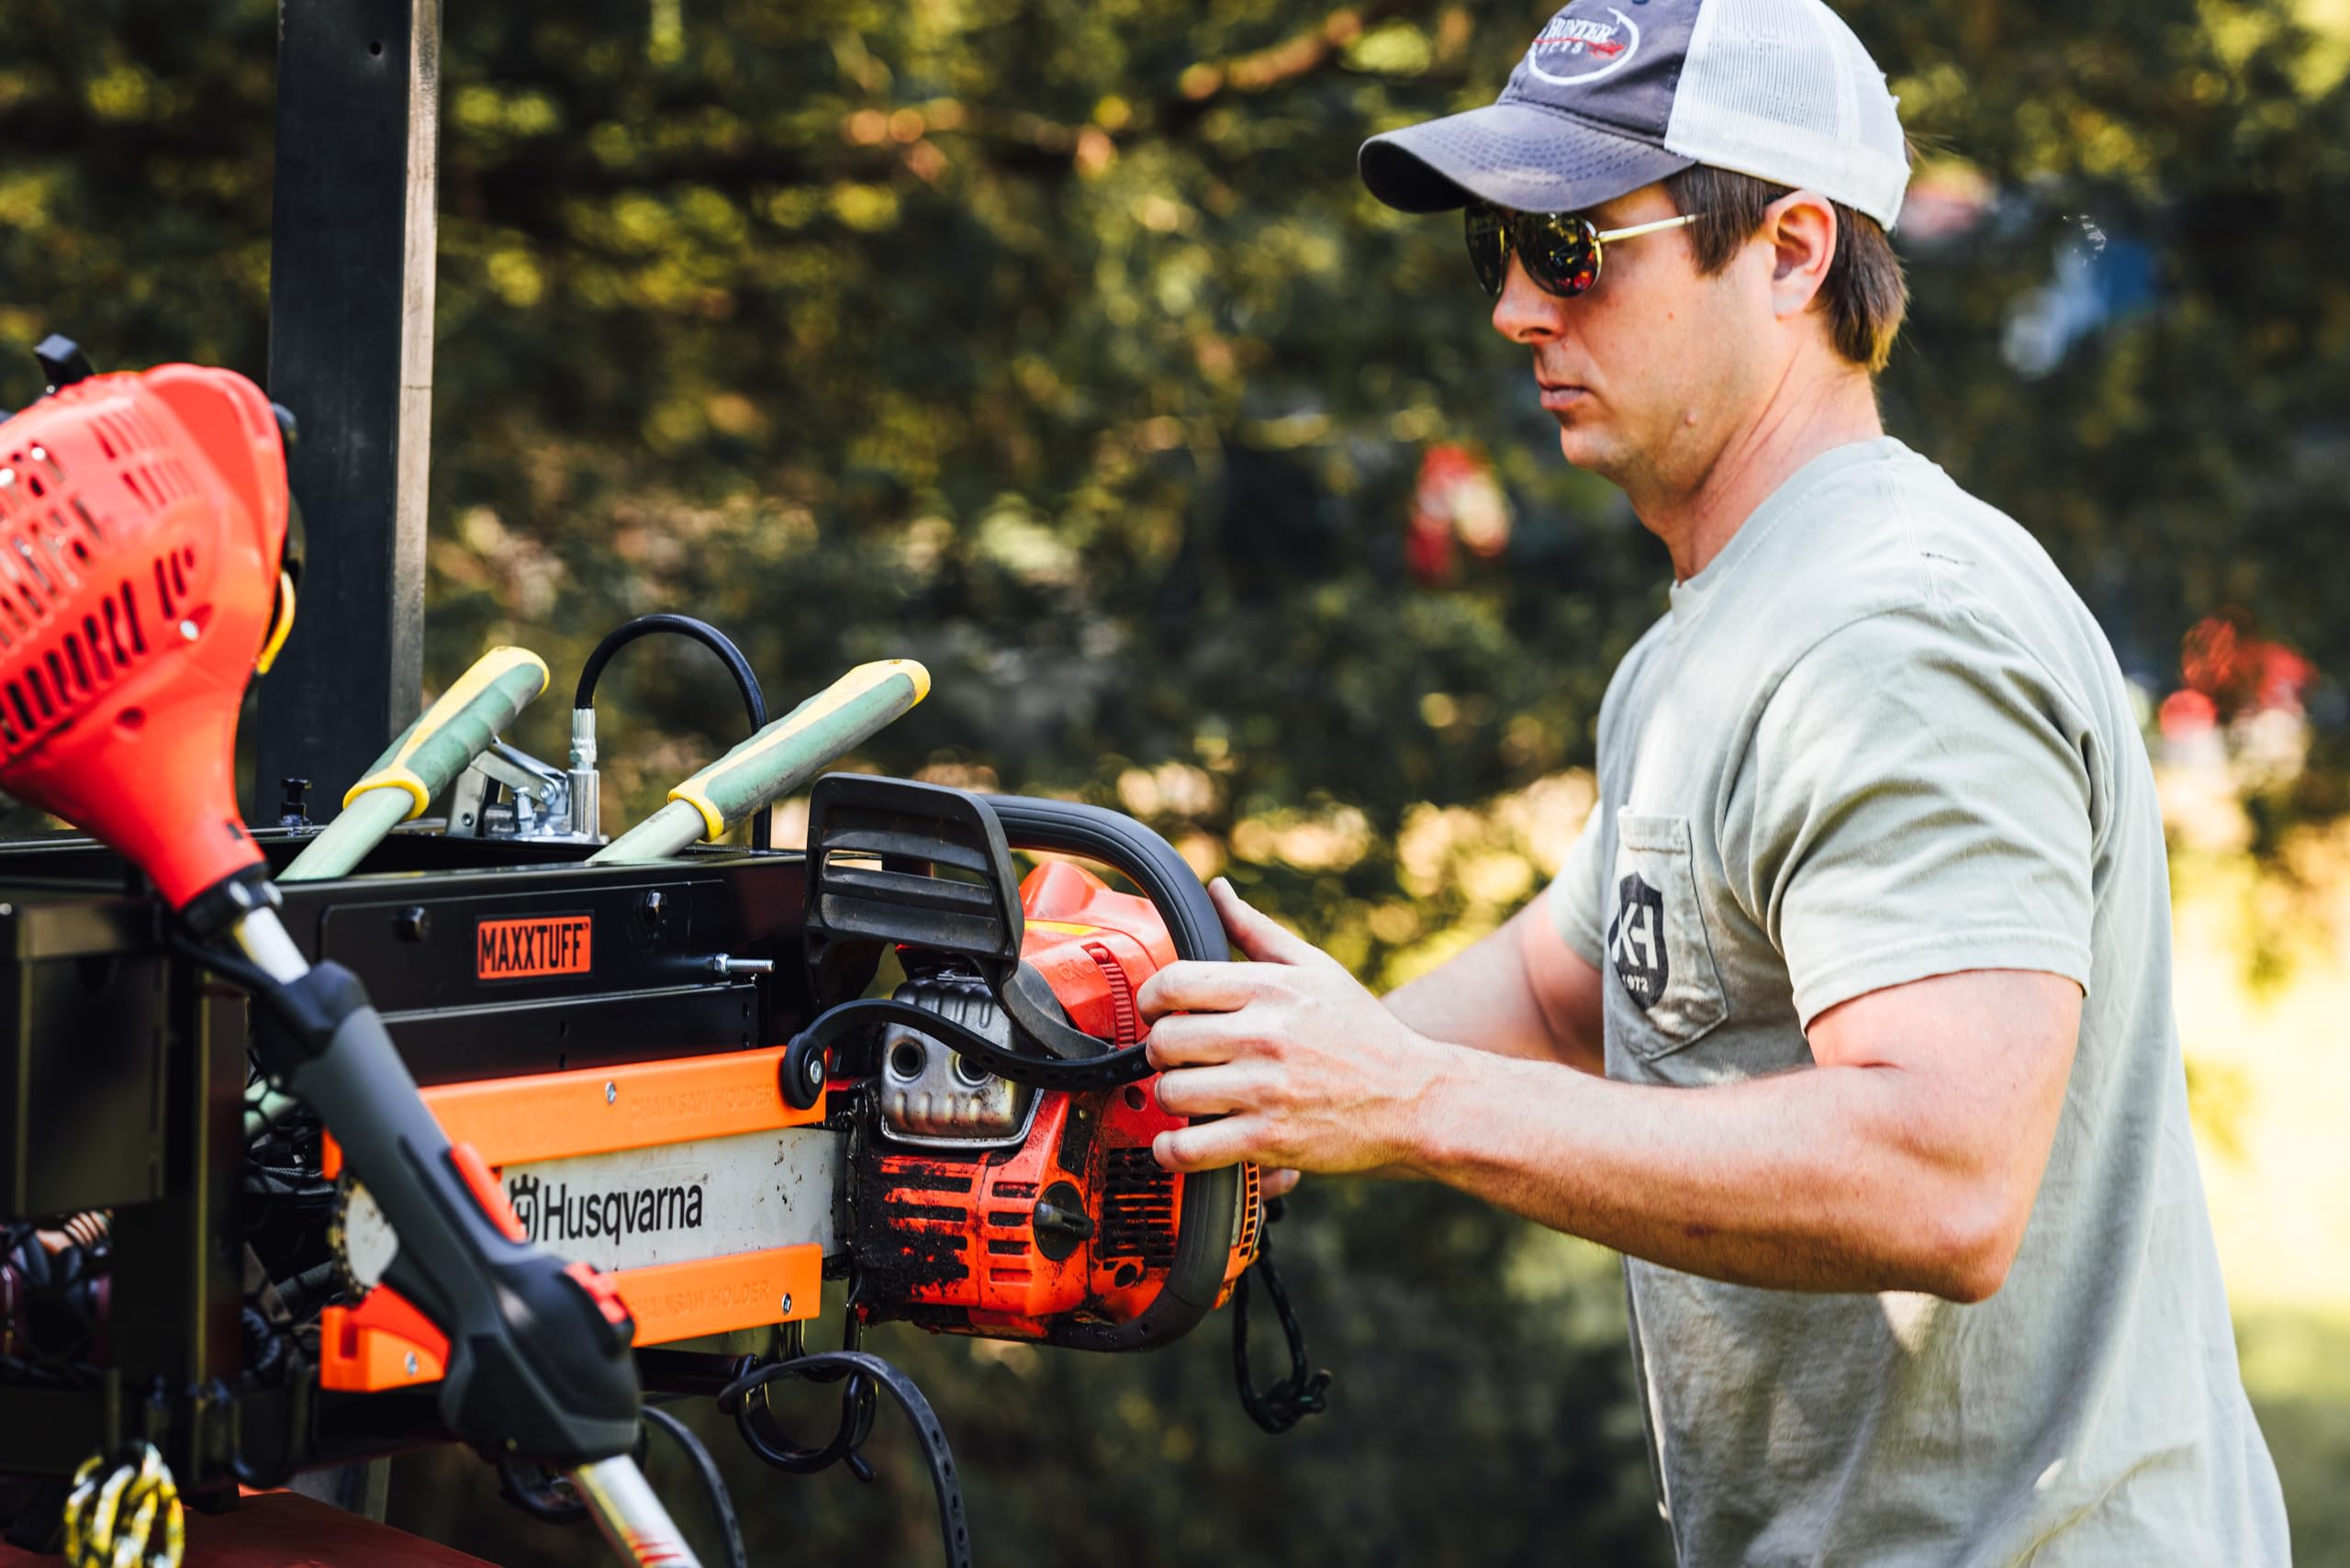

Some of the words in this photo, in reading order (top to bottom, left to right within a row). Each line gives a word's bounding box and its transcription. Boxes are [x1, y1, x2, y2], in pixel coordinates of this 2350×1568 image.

[1546, 18, 1612, 42] HUNTER
[480, 923, 586, 973] MAXXTUFF
[714, 1083, 775, 1114] HOLDER
[544, 1182, 703, 1246] Husqvarna
[710, 1279, 770, 1308] HOLDER
